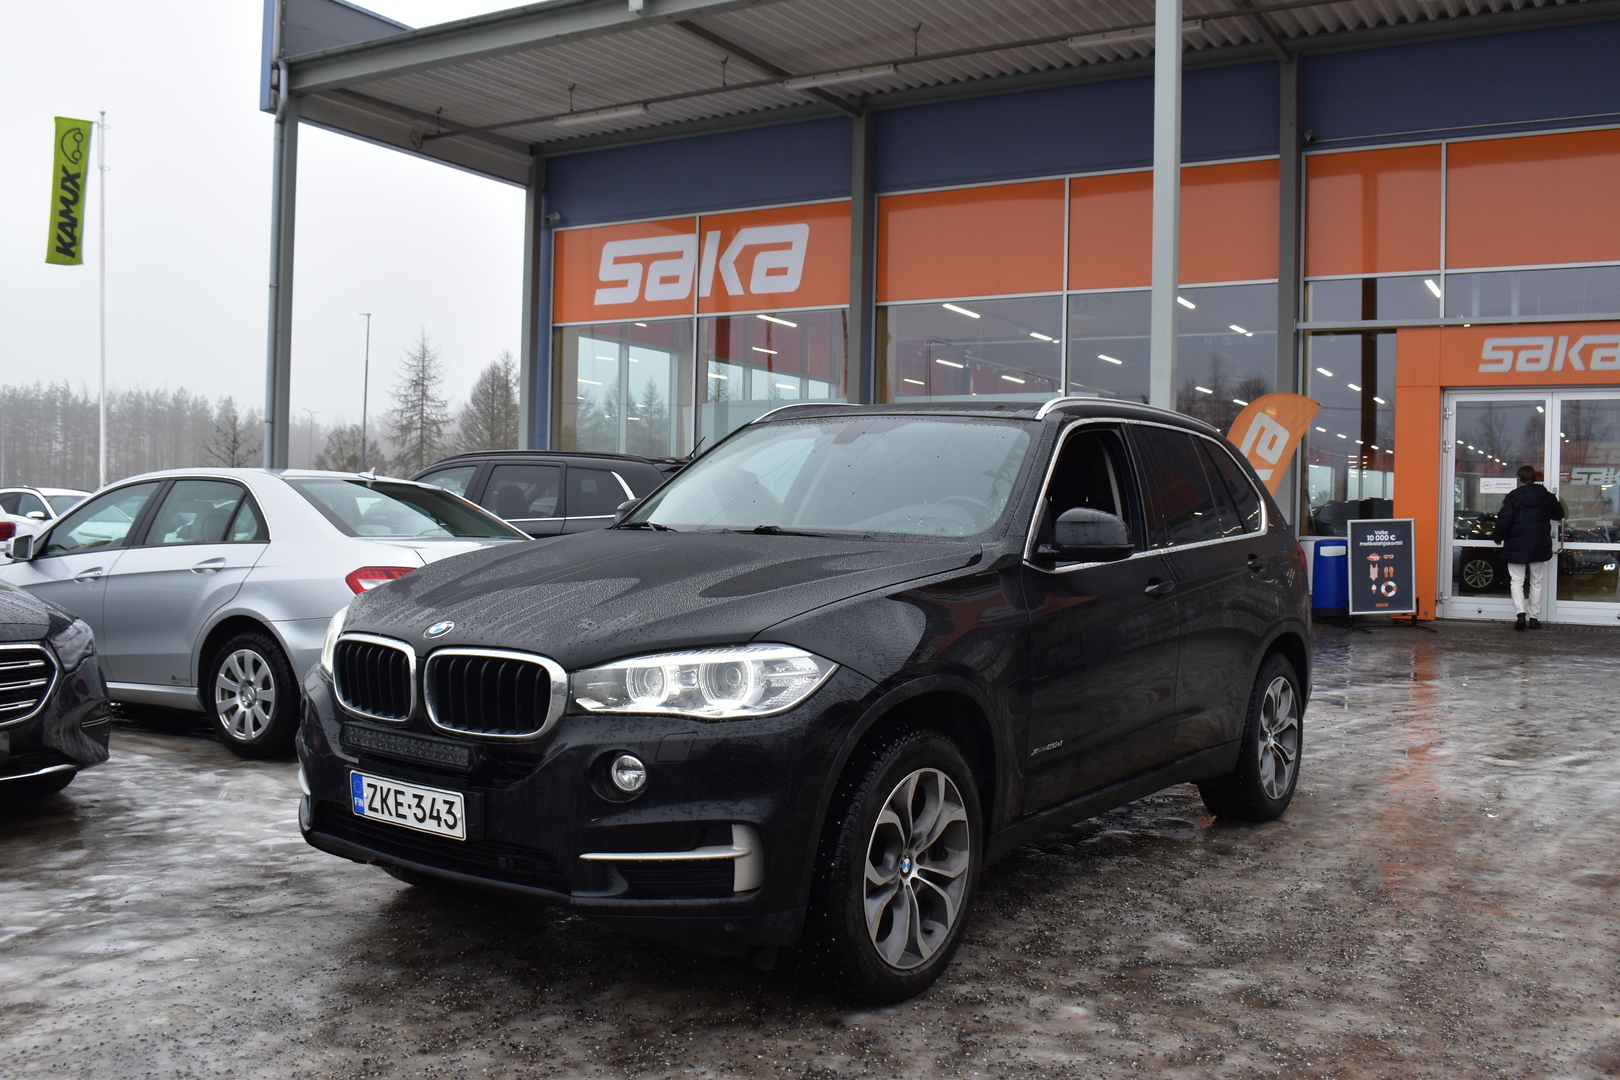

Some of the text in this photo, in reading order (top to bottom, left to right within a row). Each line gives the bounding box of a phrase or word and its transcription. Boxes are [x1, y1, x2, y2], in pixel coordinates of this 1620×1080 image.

[55, 164, 81, 258] KAMUX
[354, 796, 364, 808] FIN
[366, 782, 458, 830] ZKE-343
